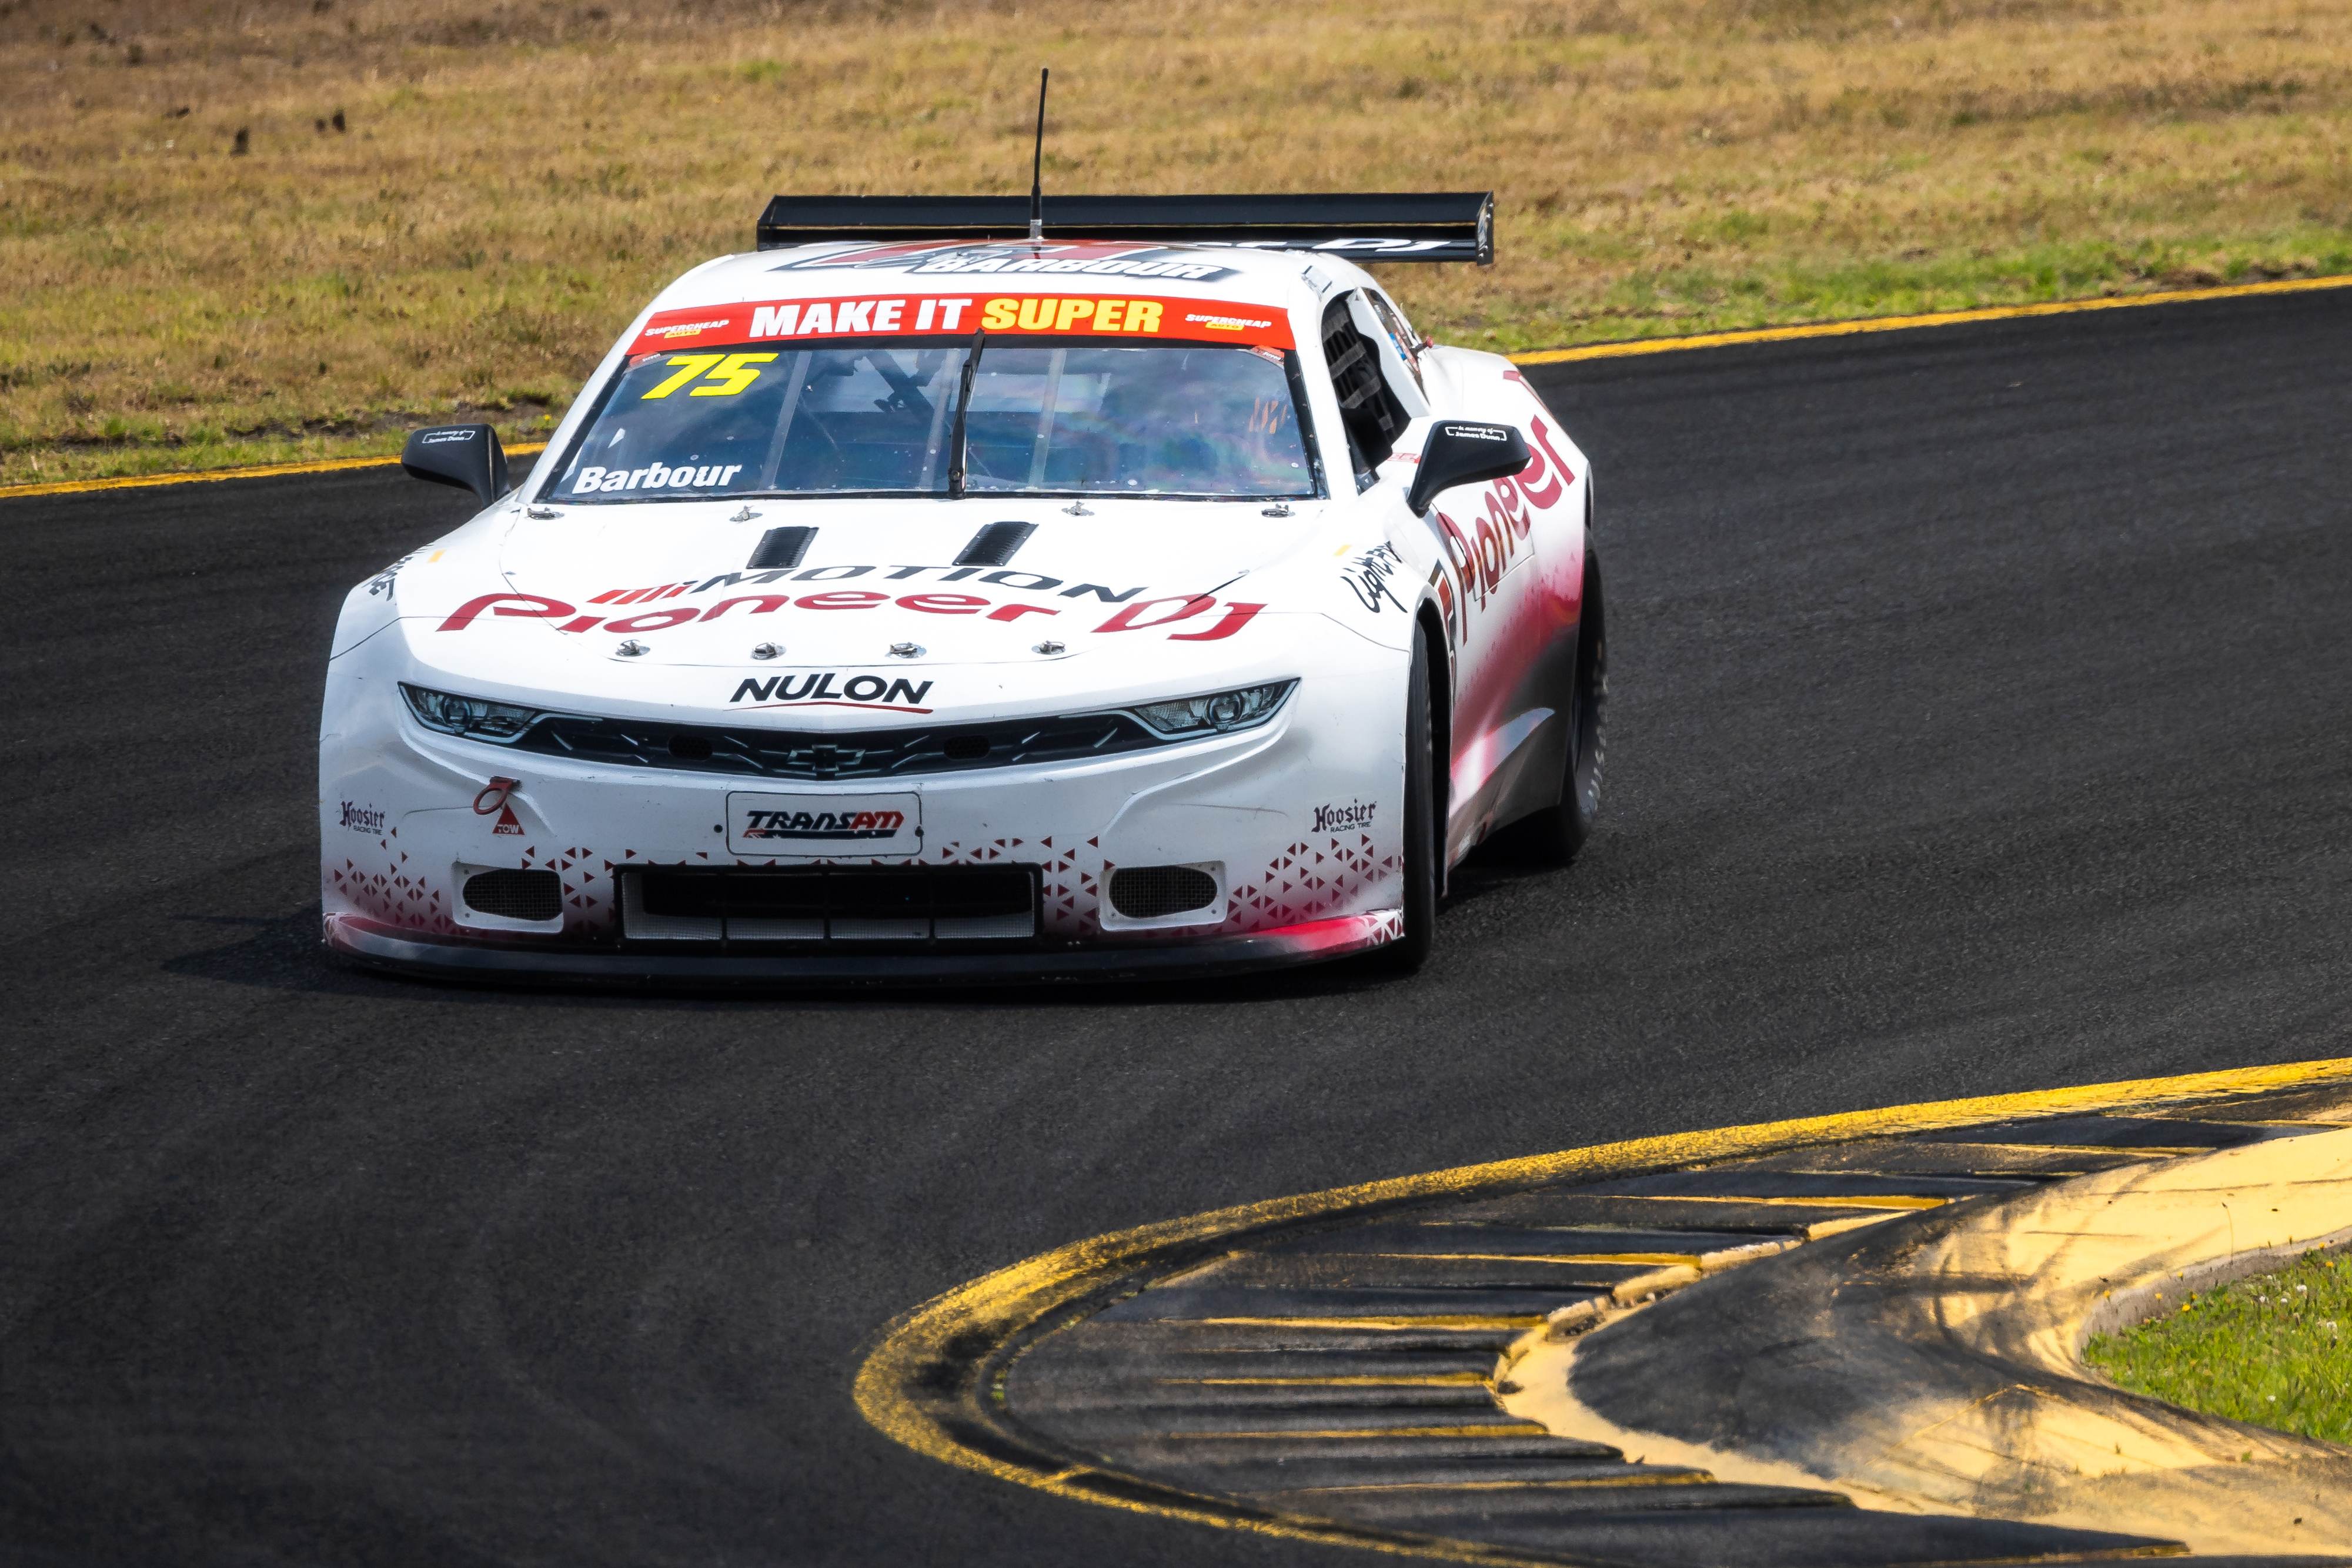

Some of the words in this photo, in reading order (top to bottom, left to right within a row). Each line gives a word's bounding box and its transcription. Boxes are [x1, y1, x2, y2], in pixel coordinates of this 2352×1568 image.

[914, 258, 1224, 279] BARBOUR
[644, 319, 730, 336] SUPERCHEAP
[749, 299, 906, 338] MAKE
[914, 299, 972, 330] IT
[981, 298, 1164, 333] SUPER
[1185, 314, 1272, 328] SUPERCHEAP
[641, 353, 779, 400] 75
[572, 462, 743, 494] Barbour
[436, 591, 1061, 633] Pioneer
[1090, 594, 1268, 641] DJ
[729, 673, 933, 704] NULON
[339, 800, 385, 831] Hoosier
[497, 824, 520, 834] TOW
[1311, 798, 1377, 833] Hoosier
[1330, 824, 1355, 833] RACING
